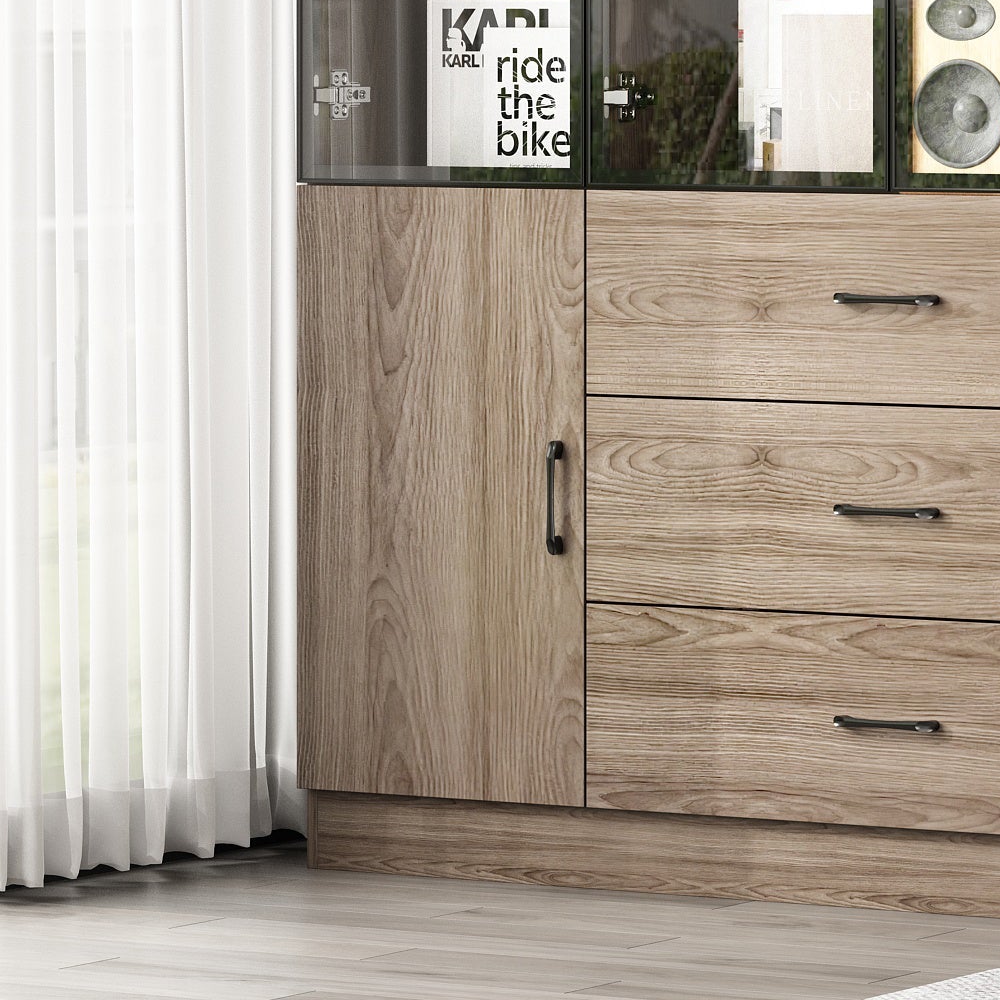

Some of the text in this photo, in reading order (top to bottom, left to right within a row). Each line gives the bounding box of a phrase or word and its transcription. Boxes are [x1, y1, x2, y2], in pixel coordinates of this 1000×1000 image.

[442, 54, 480, 68] KARL
[497, 47, 567, 83] ride
[497, 84, 556, 120] the
[497, 120, 571, 157] bike
